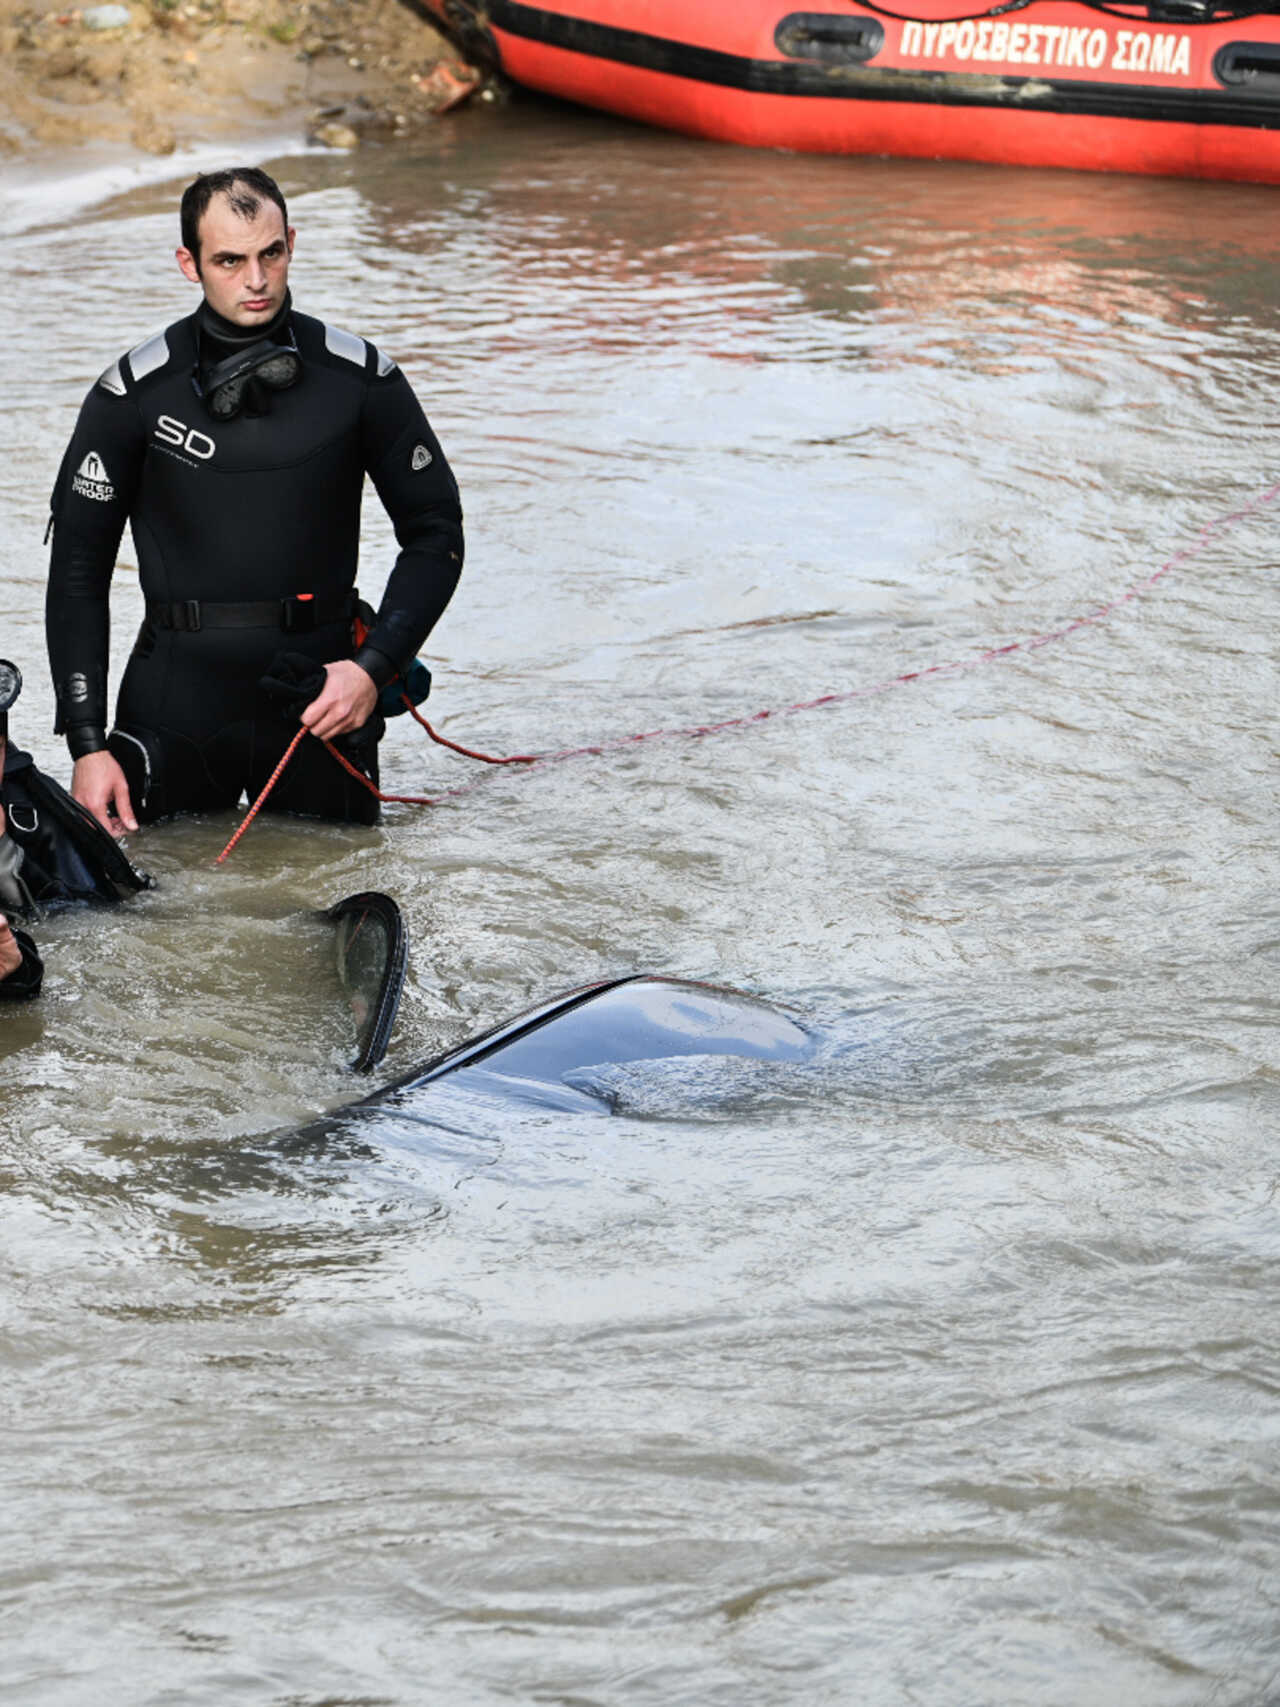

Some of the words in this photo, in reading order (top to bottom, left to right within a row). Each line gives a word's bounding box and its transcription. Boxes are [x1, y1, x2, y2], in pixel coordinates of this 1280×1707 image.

[899, 19, 1108, 69] ΠΥΡΟΣΒΕΣΤΙΚΟ
[1111, 29, 1191, 76] ΣΩΜΑ
[154, 414, 216, 460] SD
